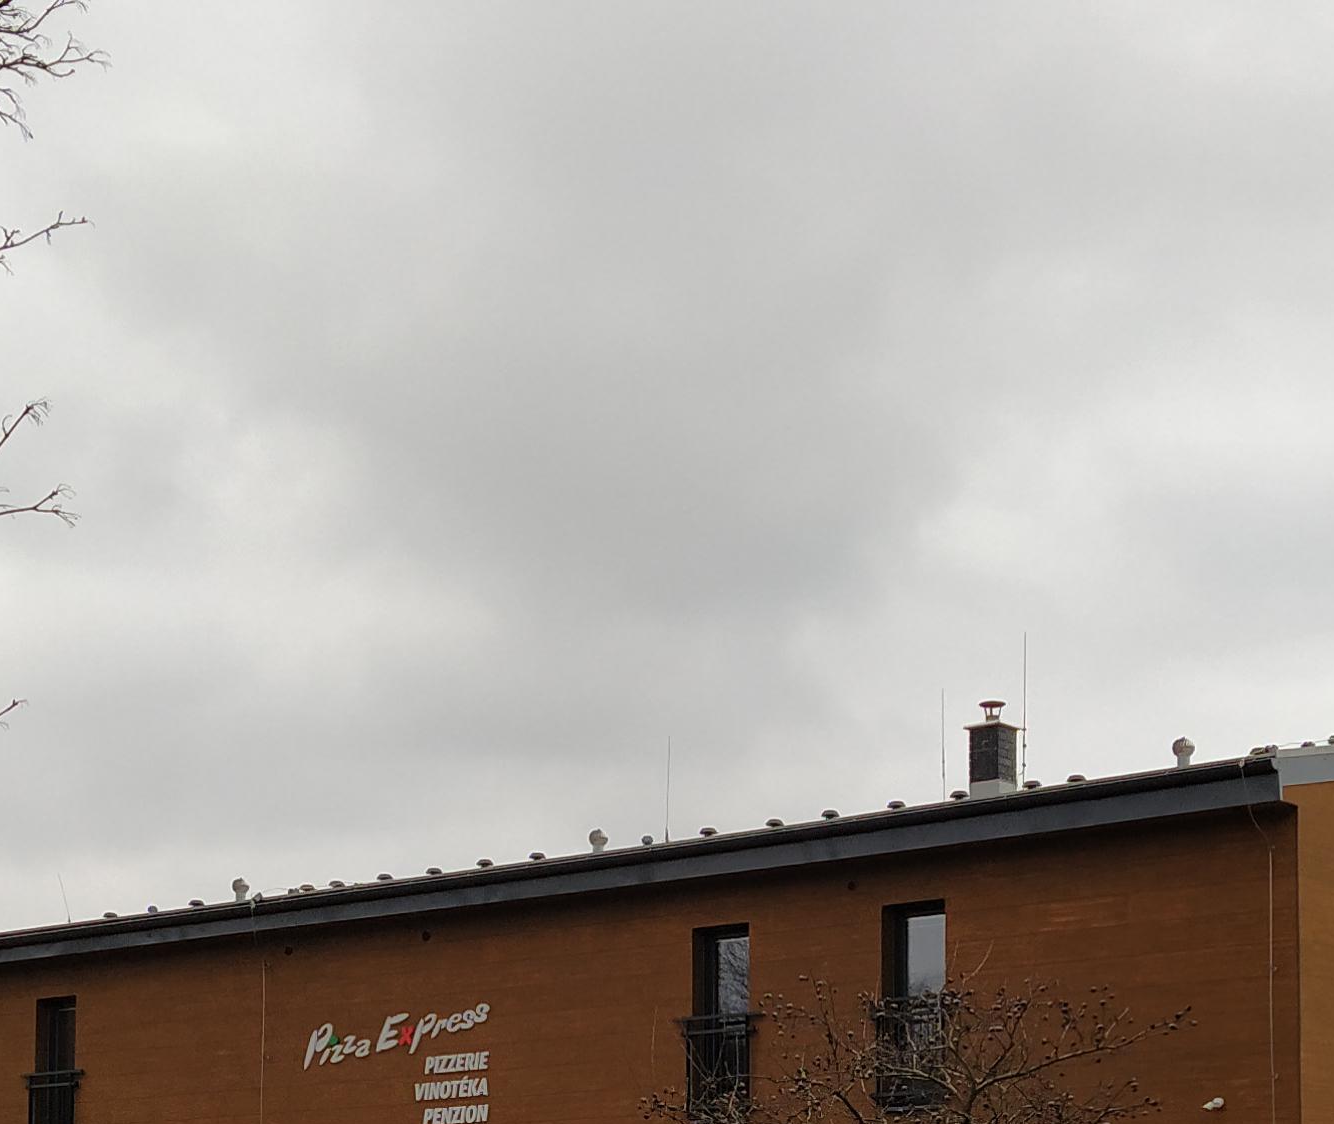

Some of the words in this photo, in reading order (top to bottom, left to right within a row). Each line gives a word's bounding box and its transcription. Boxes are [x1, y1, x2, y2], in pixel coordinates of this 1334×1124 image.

[303, 1021, 372, 1070] Pizza
[375, 1002, 491, 1055] Express
[424, 1051, 490, 1075] PIZZERIE
[414, 1075, 489, 1101] VINOTÉKA
